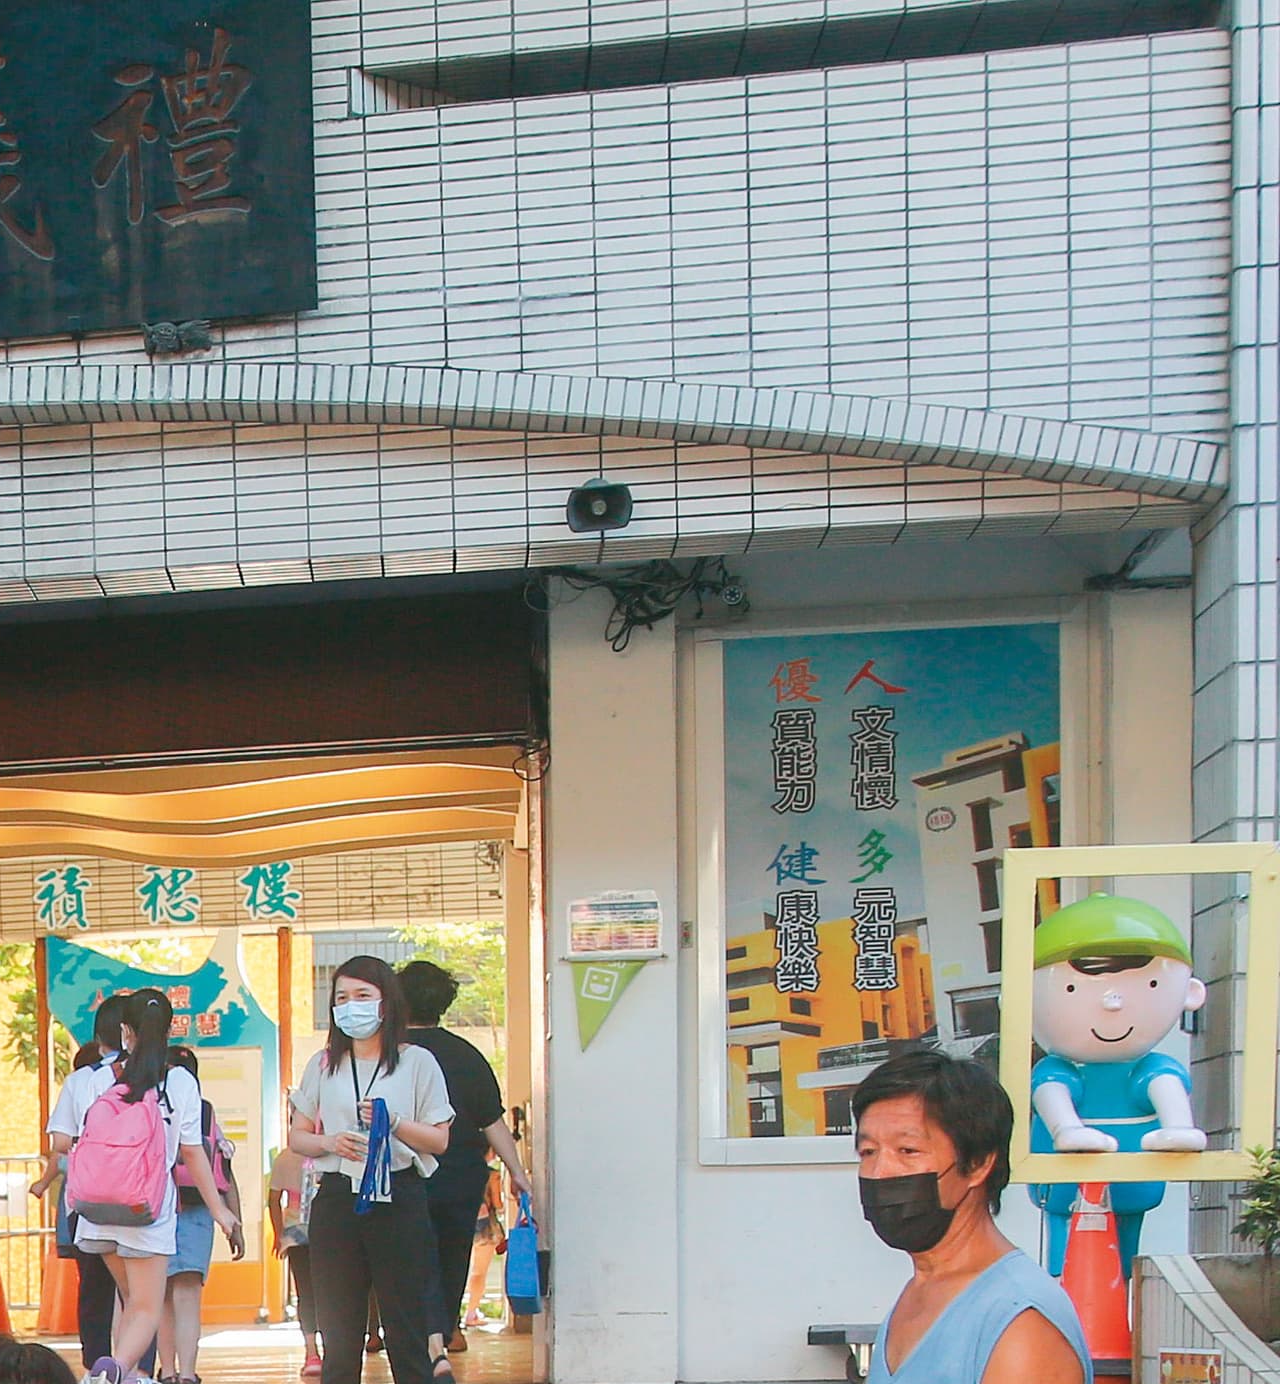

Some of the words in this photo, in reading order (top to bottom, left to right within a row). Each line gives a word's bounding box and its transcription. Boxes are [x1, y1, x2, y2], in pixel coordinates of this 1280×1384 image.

[767, 656, 823, 813] 優質能力
[845, 659, 907, 812] 人文情懷
[765, 841, 828, 994] 健康快樂
[849, 828, 899, 994] 多元智慧
